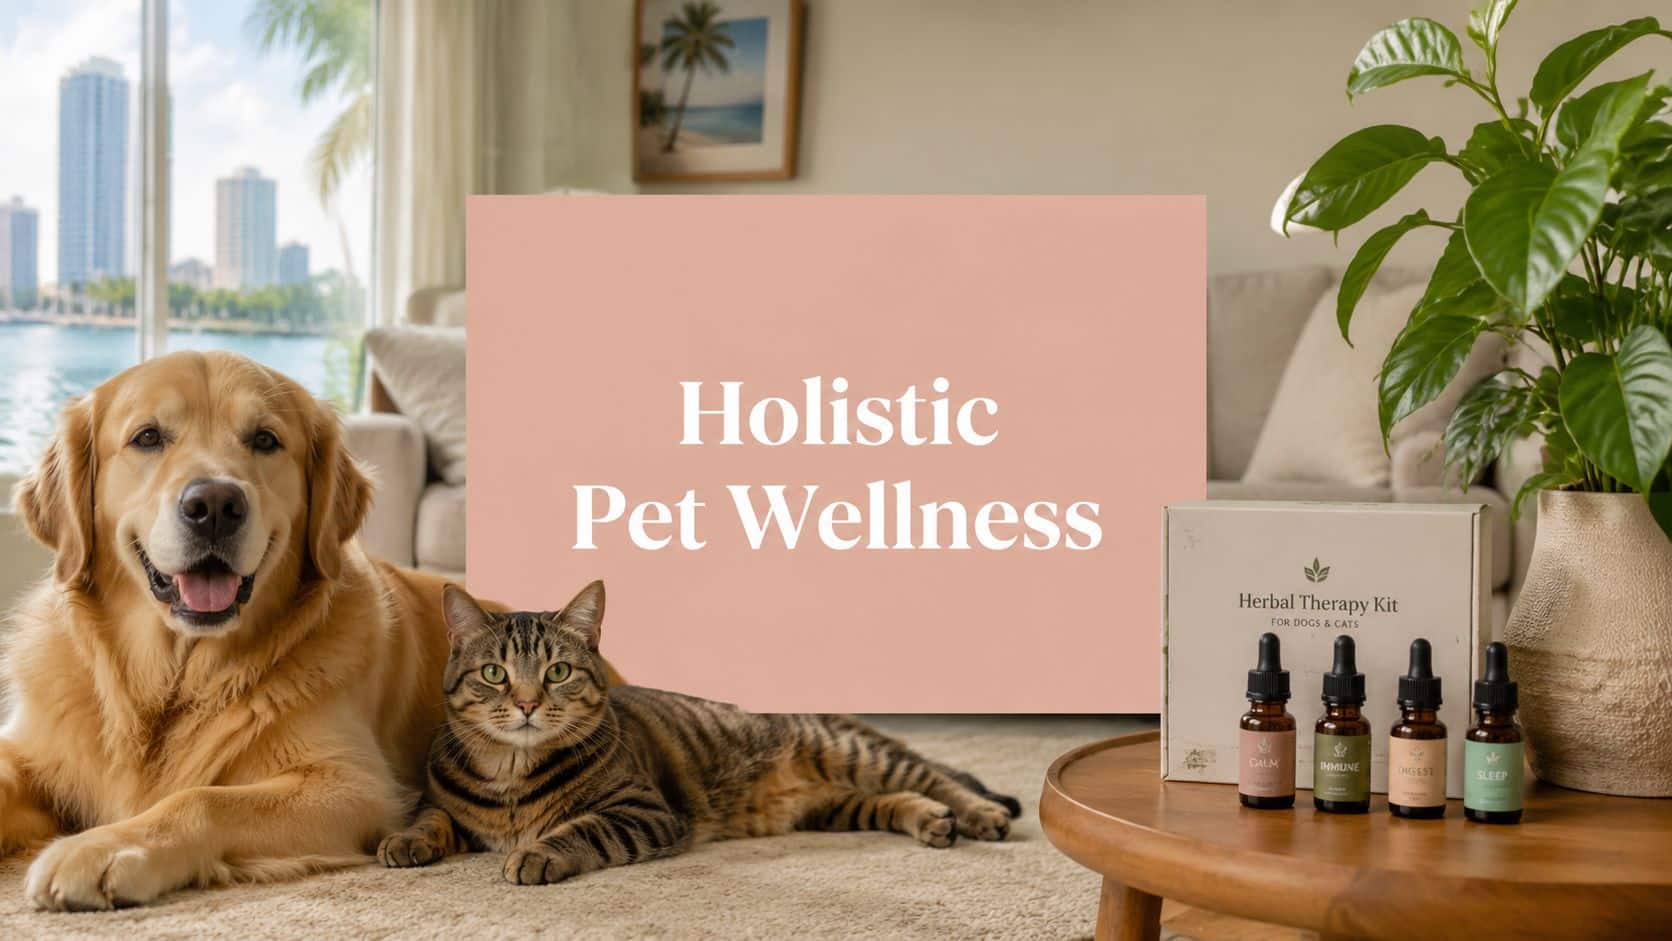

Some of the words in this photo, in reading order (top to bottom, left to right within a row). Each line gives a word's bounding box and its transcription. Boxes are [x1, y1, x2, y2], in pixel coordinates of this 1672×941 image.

[1239, 592, 1295, 610] Herbal
[1298, 594, 1369, 617] Therapy
[1373, 596, 1399, 613] Kit
[1271, 617, 1290, 627] FOR
[1293, 618, 1321, 628] DOGS
[1324, 619, 1331, 628] &
[1334, 619, 1360, 629] CATS
[1248, 757, 1280, 769] CALM
[1319, 761, 1360, 772] IMMUNE
[1398, 766, 1434, 777] DIGEST
[1476, 770, 1509, 782] SLEEP
